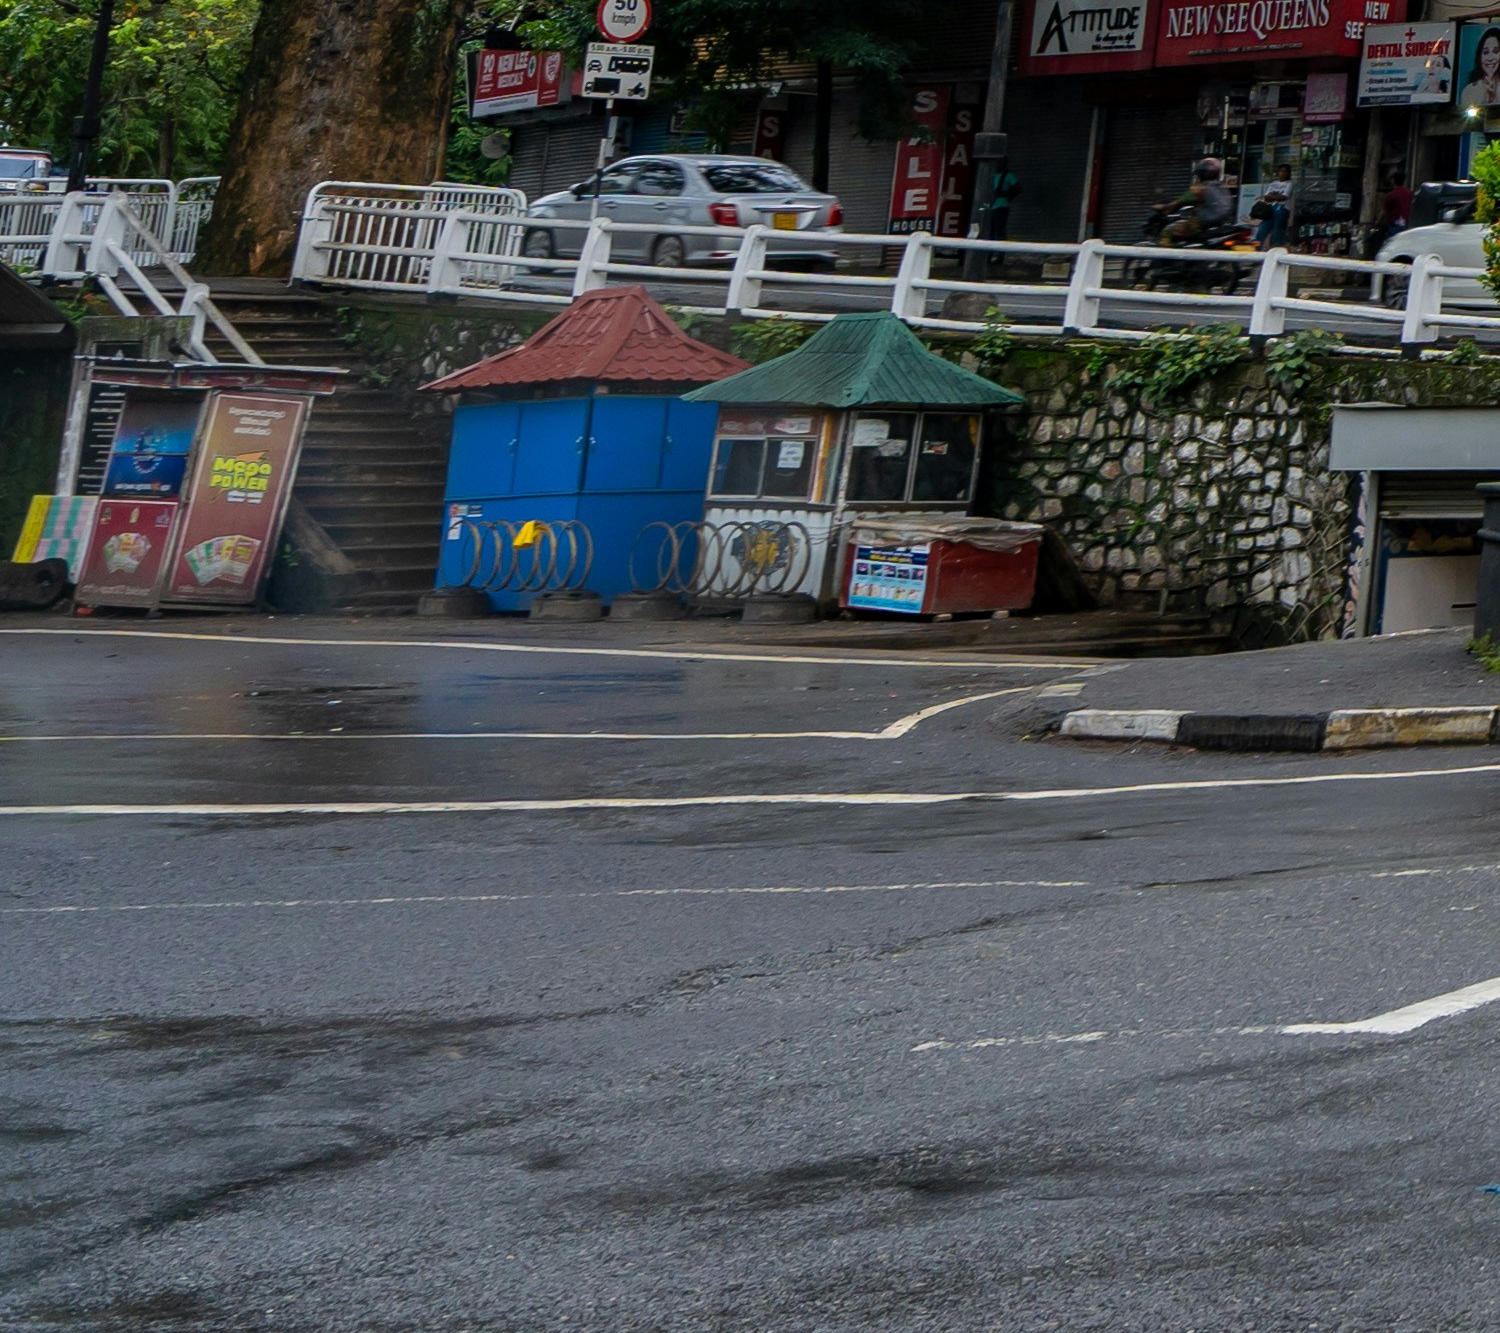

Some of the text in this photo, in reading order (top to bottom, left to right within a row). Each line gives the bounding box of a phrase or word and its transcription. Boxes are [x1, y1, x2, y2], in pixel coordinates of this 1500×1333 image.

[612, 13, 636, 26] kmph
[1166, 5, 1214, 38] NEW
[1213, 2, 1250, 34] SEE
[1364, 1, 1390, 20] NEW
[1344, 21, 1364, 39] SEE
[1367, 40, 1451, 59] DENTAL SURGERY
[904, 90, 938, 211] SLE
[892, 217, 932, 232] HOUSE
[212, 456, 272, 476] Mega
[210, 473, 268, 491] POWER
